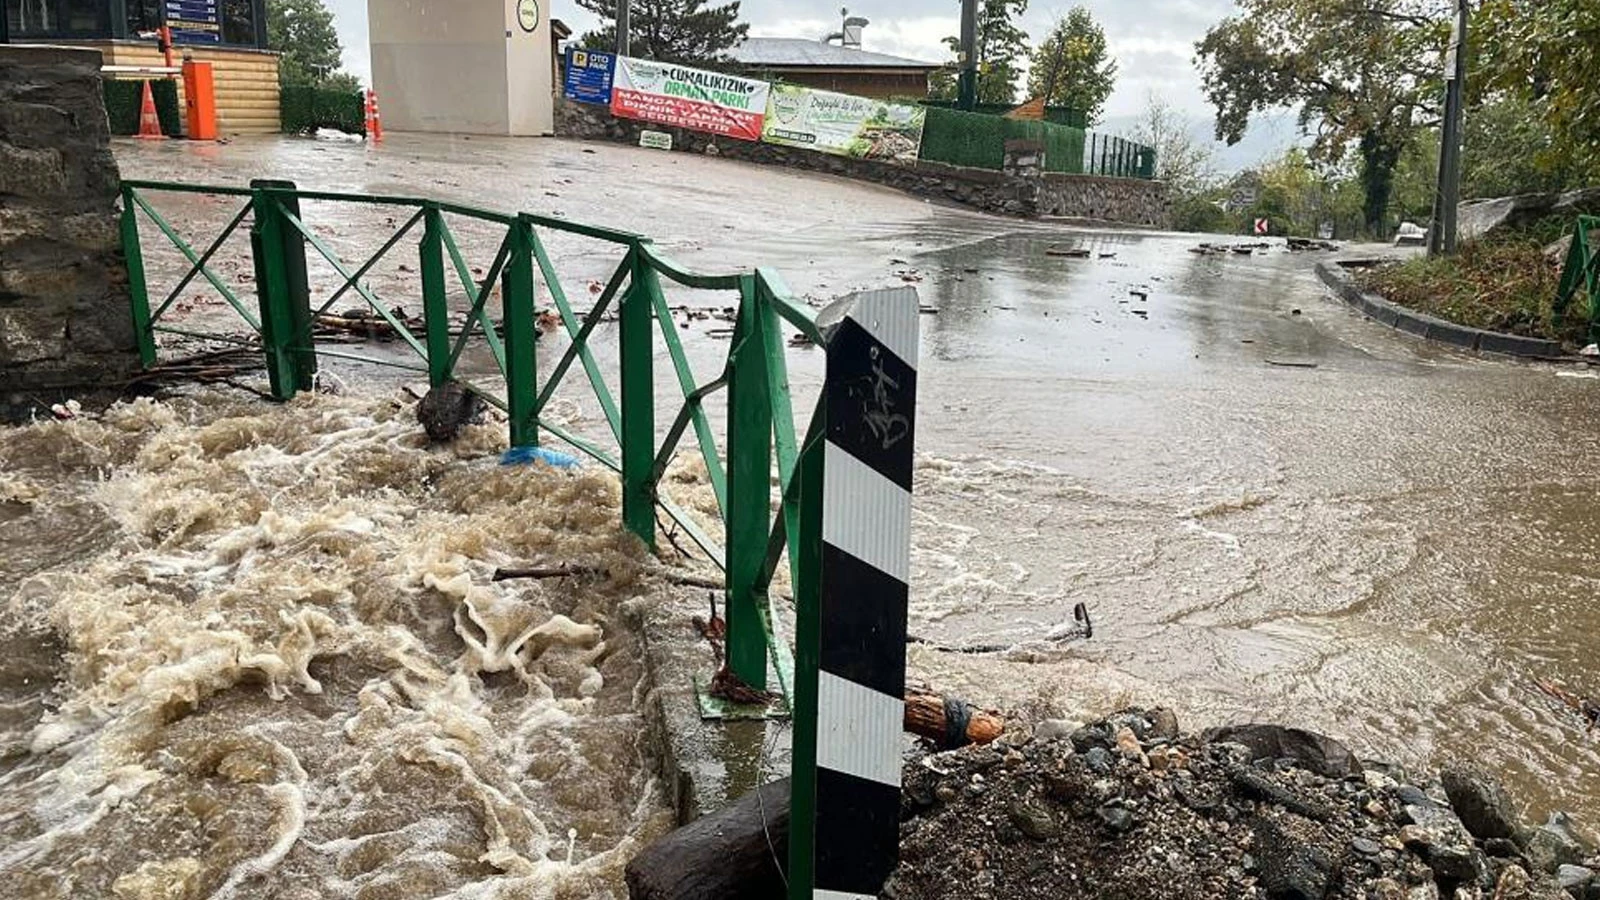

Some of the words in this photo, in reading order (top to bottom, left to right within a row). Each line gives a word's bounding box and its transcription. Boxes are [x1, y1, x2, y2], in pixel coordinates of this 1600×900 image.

[589, 53, 609, 64] OTO
[669, 68, 748, 94] CUMALIKIZIK
[618, 91, 685, 109] MANGAL
[664, 80, 708, 101] ORMAN
[712, 90, 750, 109] PARKI
